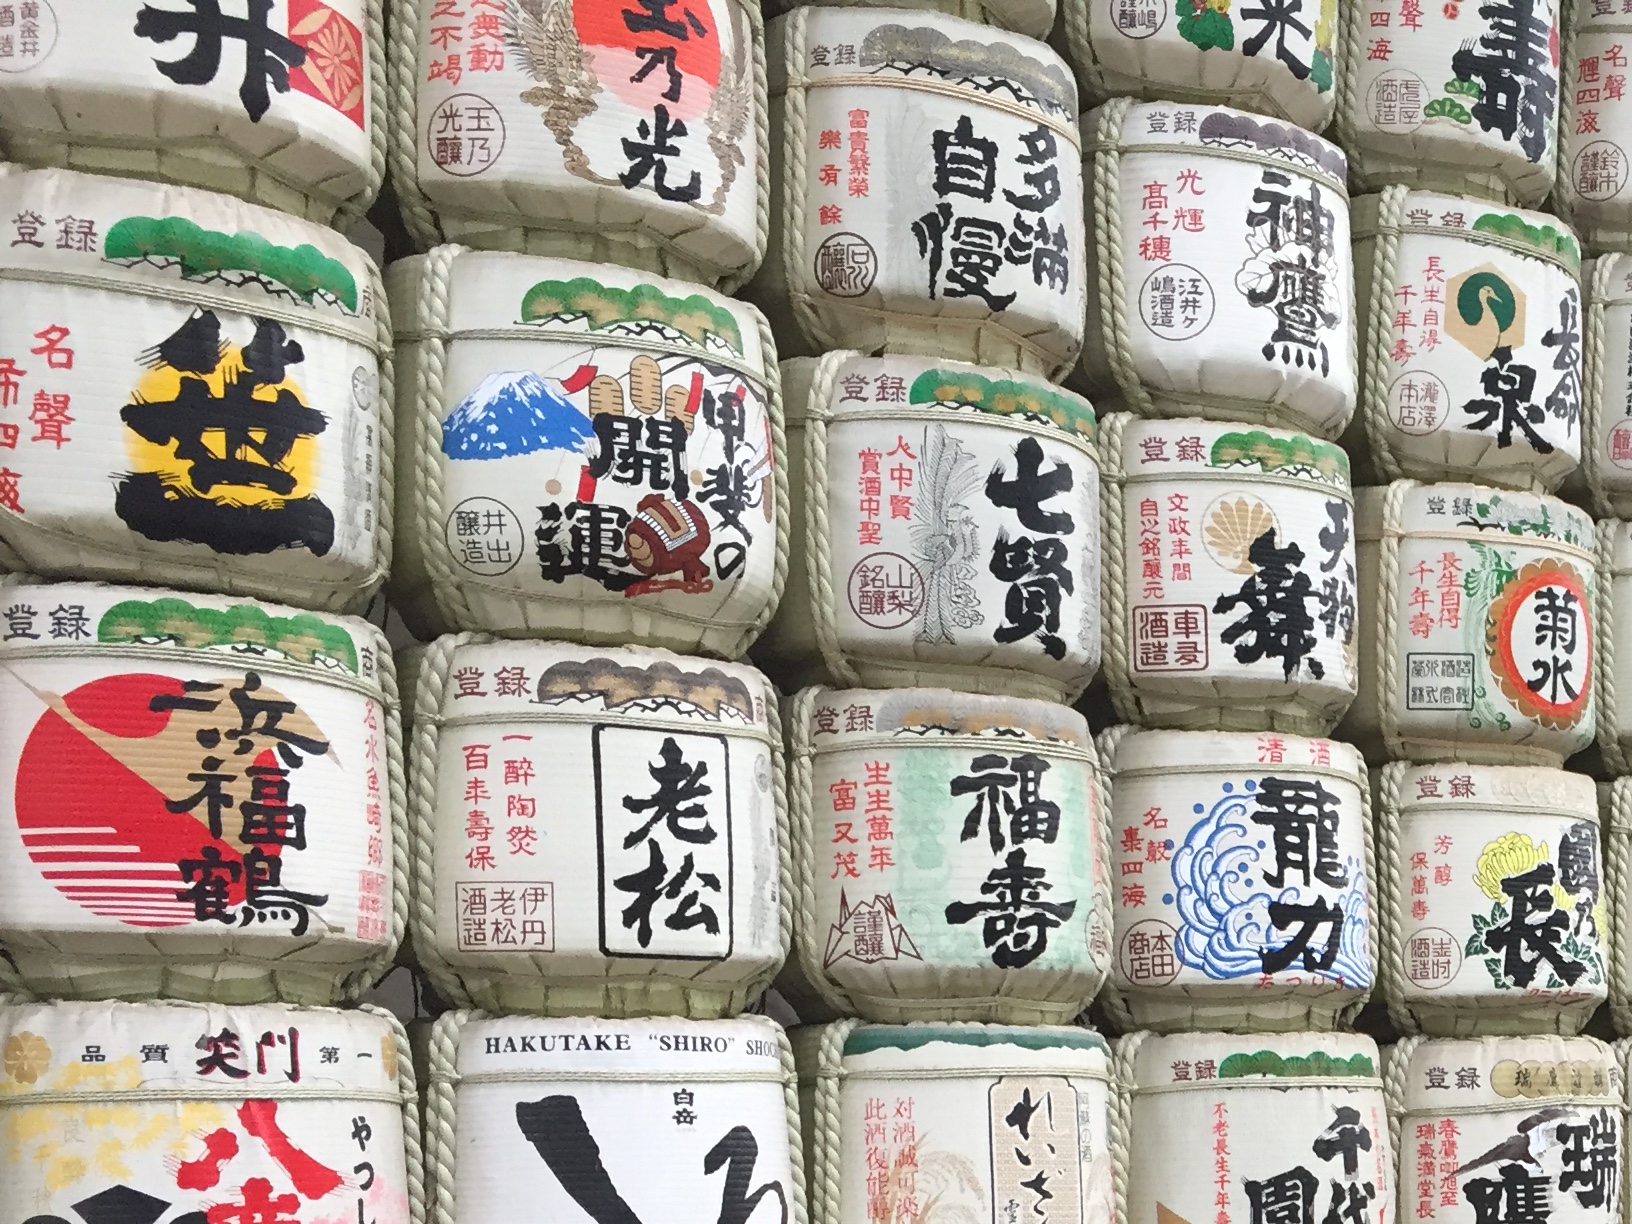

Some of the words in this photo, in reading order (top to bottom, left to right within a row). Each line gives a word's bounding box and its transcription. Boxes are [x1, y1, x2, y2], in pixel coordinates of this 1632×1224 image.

[810, 44, 856, 68] 登録
[1367, 12, 1393, 62] 四海
[1146, 111, 1198, 134] 登録
[1375, 78, 1399, 125] 酒造
[911, 115, 1017, 312] 自慢
[1172, 168, 1206, 232] 光輝
[11, 211, 98, 252] 登録
[839, 373, 907, 403] 登録
[1397, 380, 1418, 428] 本店
[1461, 346, 1554, 454] 泉
[1139, 436, 1206, 464] 登録
[536, 411, 690, 592] 開運
[886, 435, 917, 521] 人中賢
[1426, 495, 1473, 516] 登録
[483, 510, 512, 566] 井出
[985, 436, 1076, 661] 七賢
[887, 564, 914, 616] 山梨
[2, 604, 91, 642] 登録
[1139, 610, 1169, 666] 酒造
[1527, 587, 1581, 706] 菊水
[453, 666, 531, 700] 登録
[813, 703, 874, 737] 登録
[1257, 737, 1331, 767] 清酒
[1416, 775, 1477, 801] 登録
[613, 737, 721, 949] 老松
[1434, 834, 1454, 887] 芳醇
[1251, 776, 1349, 974] 龍力
[491, 888, 518, 946] 老松
[519, 888, 548, 946] 伊丹
[1128, 931, 1151, 979] 商店
[1151, 929, 1175, 977] 本田
[81, 1045, 171, 1063] 品質
[195, 1027, 300, 1083] 笑門
[319, 1046, 373, 1063] 第一
[485, 1034, 632, 1055] HAKUTAKE
[1171, 1059, 1217, 1082] 登録
[1424, 1066, 1482, 1091] 登録
[672, 1088, 698, 1126] 白岳
